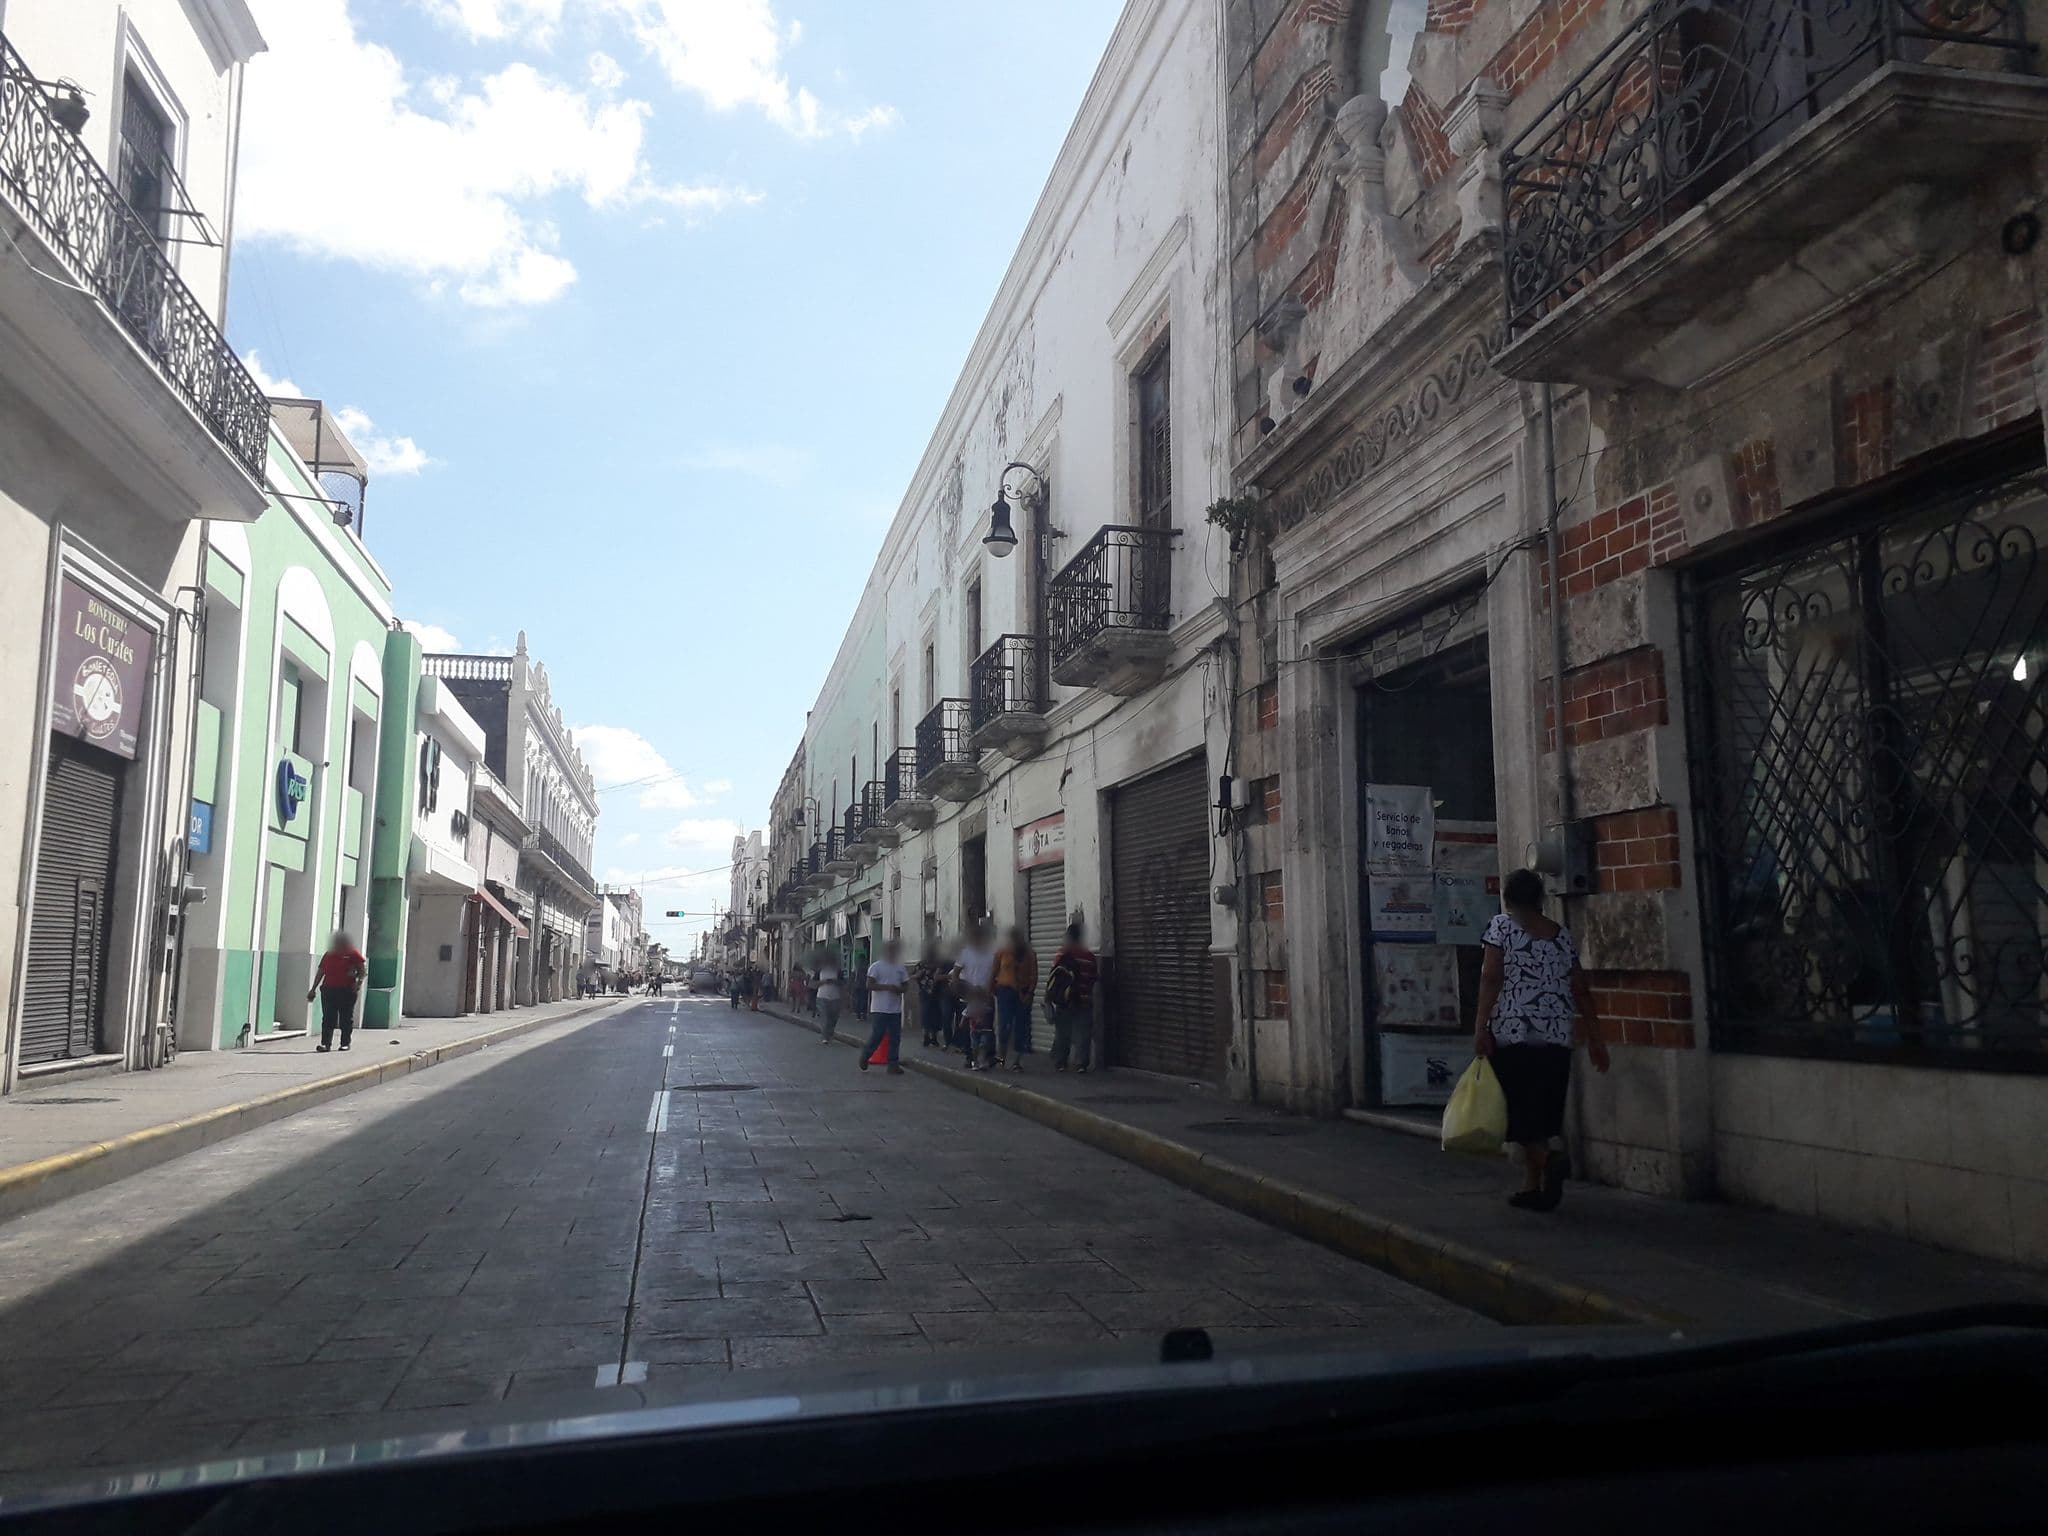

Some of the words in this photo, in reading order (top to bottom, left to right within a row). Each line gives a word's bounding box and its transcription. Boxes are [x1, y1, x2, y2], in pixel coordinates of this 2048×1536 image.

[75, 611, 97, 644] Los
[99, 626, 134, 665] Cuates
[1376, 811, 1409, 822] Servicio
[1410, 813, 1421, 824] de
[1382, 840, 1424, 851] regaderas
